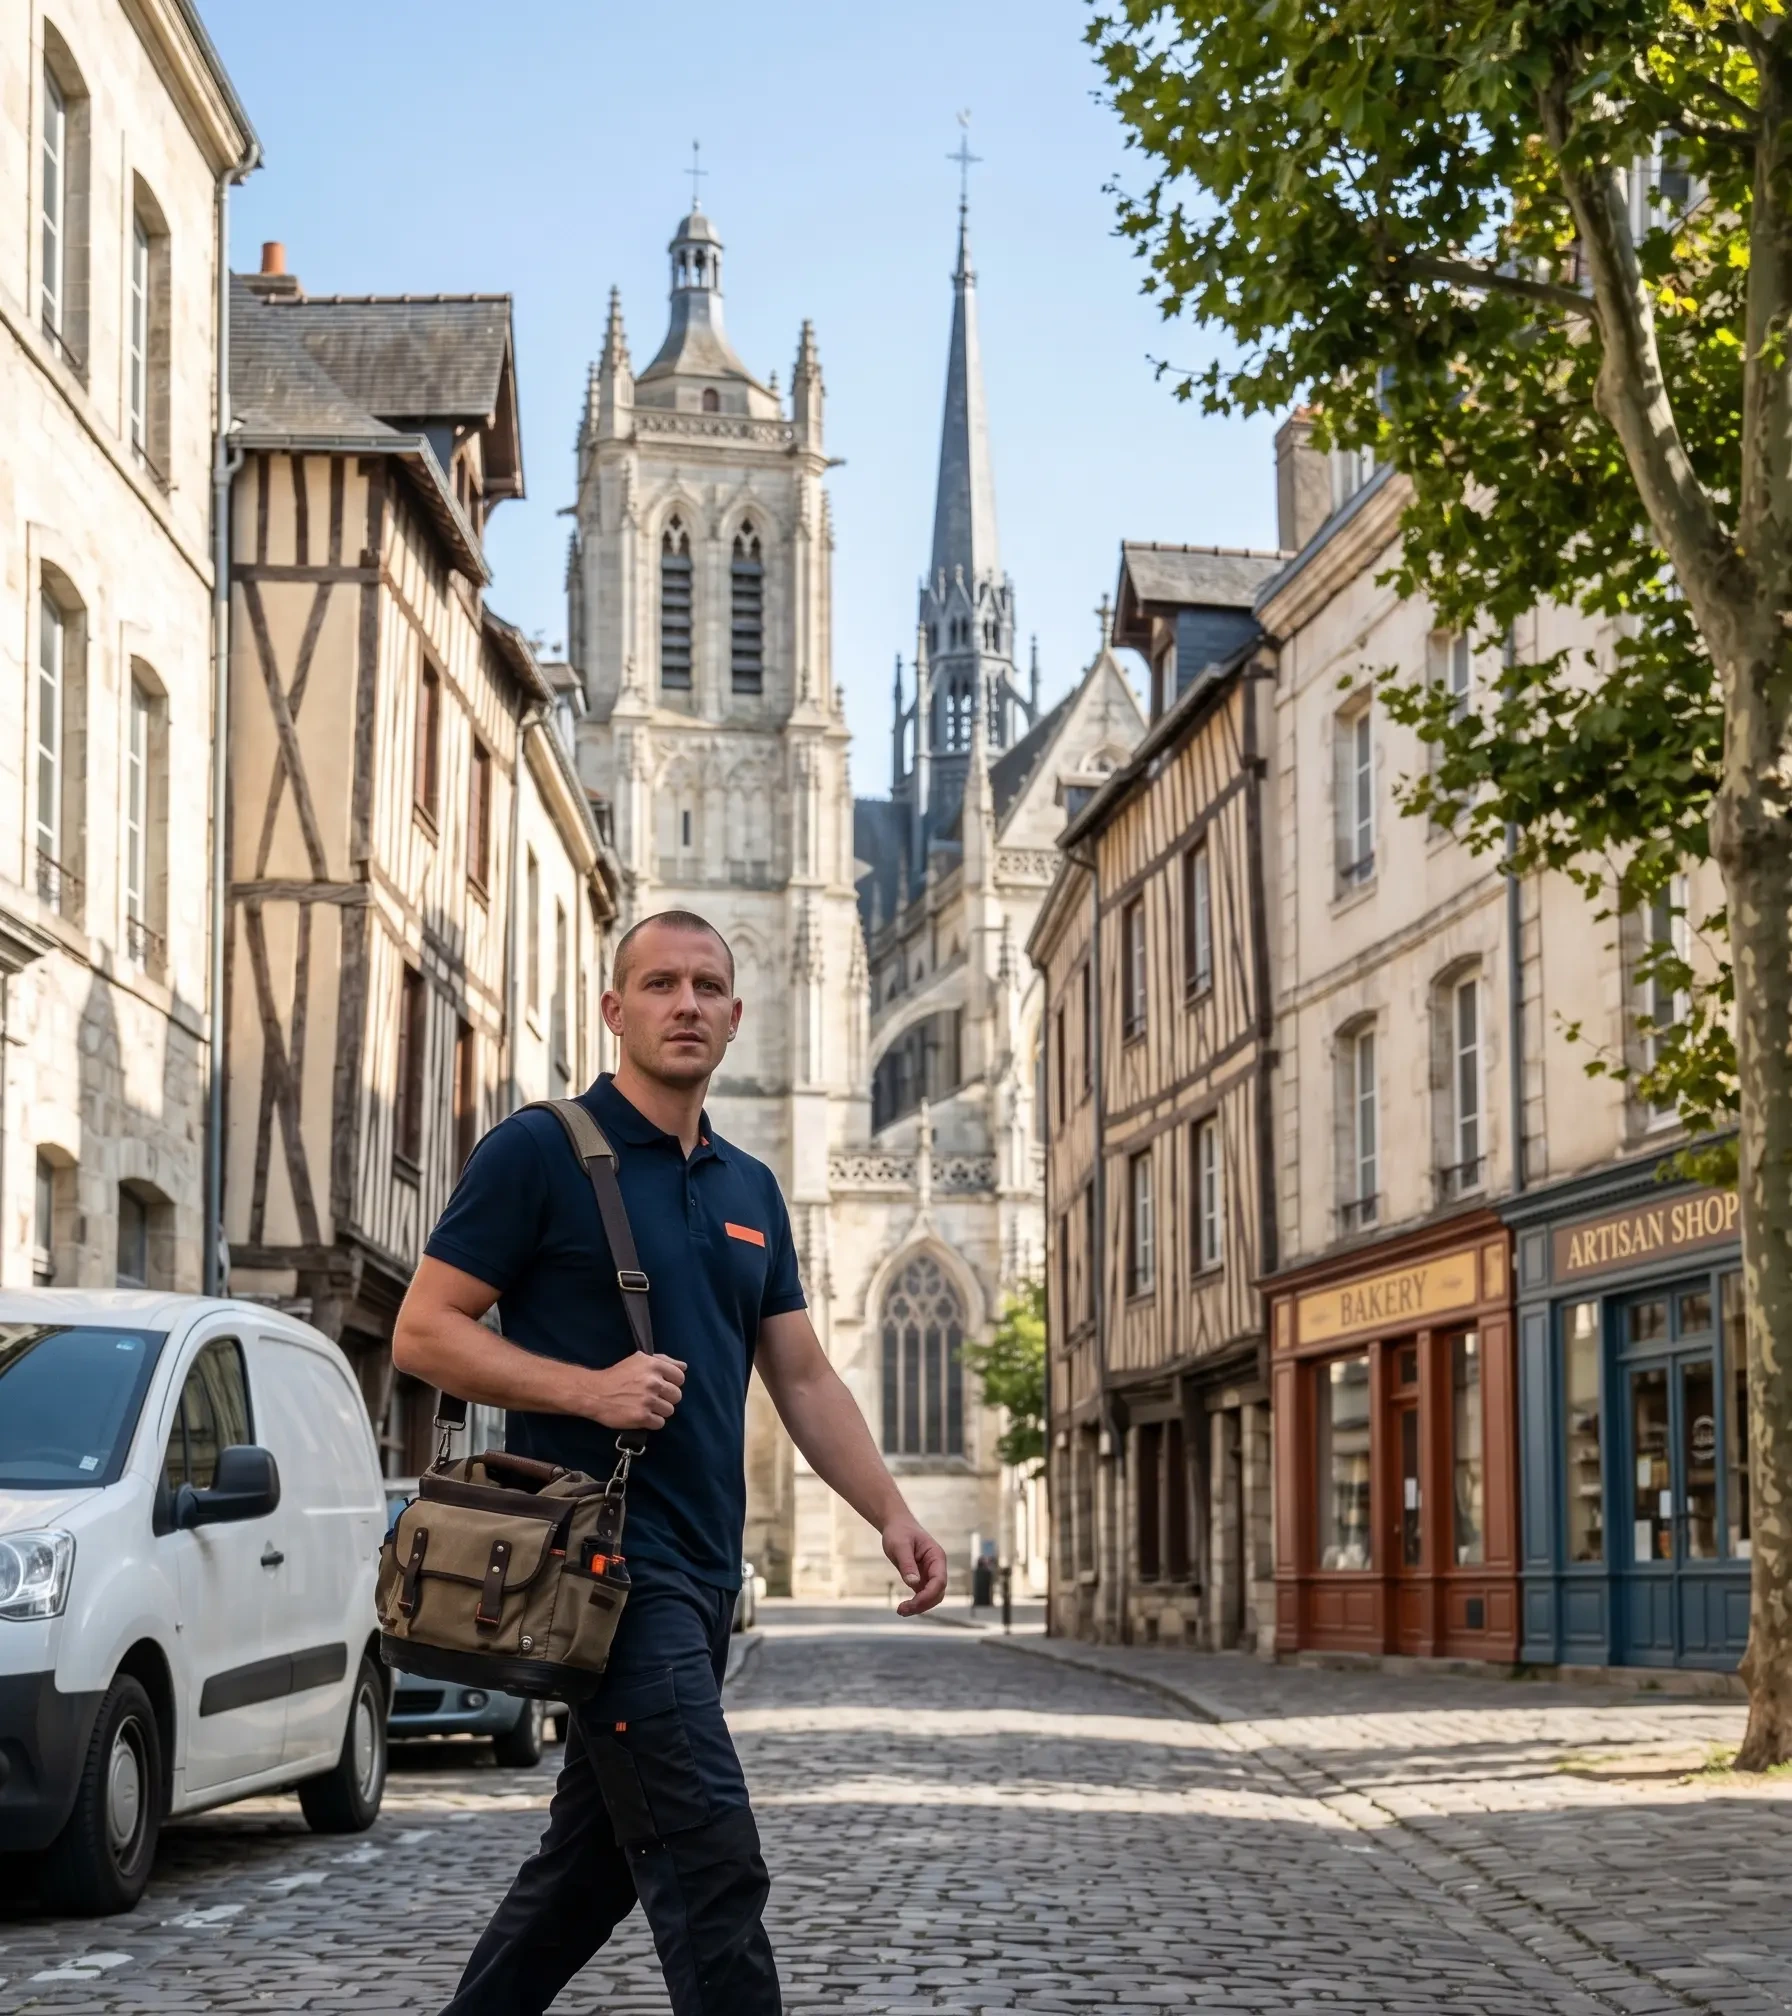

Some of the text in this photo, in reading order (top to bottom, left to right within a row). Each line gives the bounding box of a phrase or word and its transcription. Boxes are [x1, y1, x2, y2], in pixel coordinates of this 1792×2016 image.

[1566, 1192, 1739, 1270] ARTISAN SHOP
[1340, 1270, 1428, 1327] BAKERY
